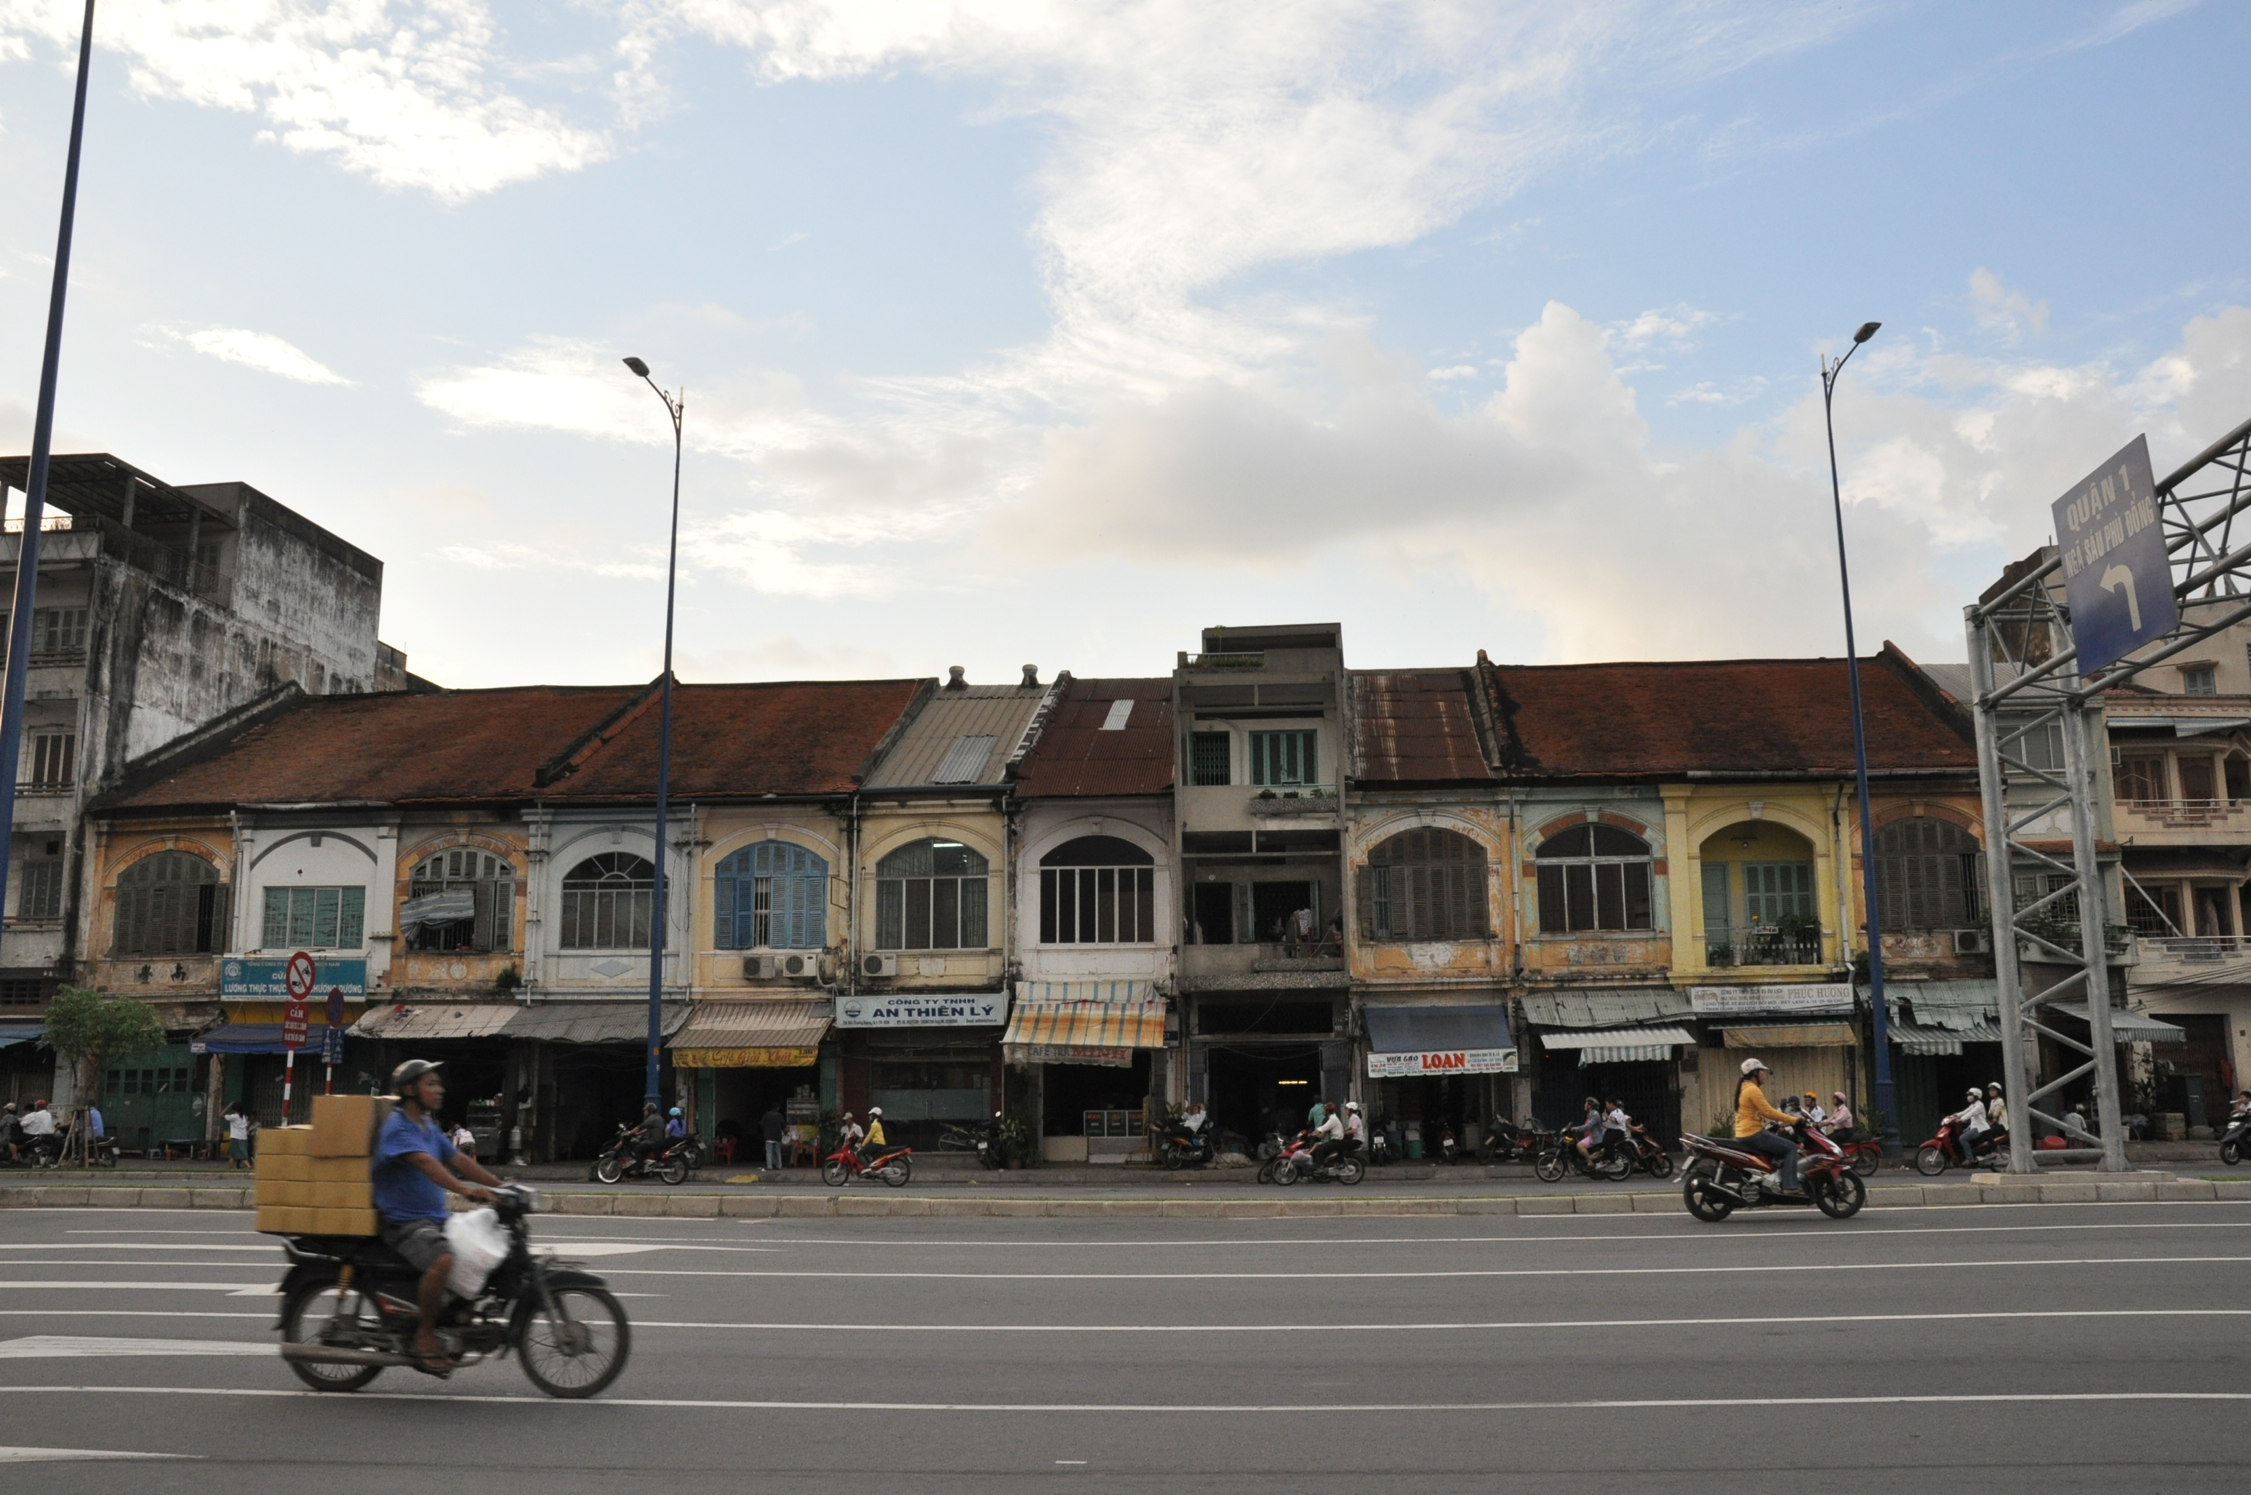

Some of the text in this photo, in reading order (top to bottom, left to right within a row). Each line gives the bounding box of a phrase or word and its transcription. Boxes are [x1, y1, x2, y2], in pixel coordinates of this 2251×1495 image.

[2066, 463, 2130, 531] QUẬN 1
[2064, 540, 2085, 578] NGÃ
[2084, 528, 2104, 565] SÁU
[2104, 512, 2124, 552] PHÙ
[1788, 986, 1814, 999] PHÚC
[1816, 986, 1850, 998] HƯƠNG
[872, 1004, 994, 1017] AN THIÊN LÝ
[1422, 1052, 1466, 1069] LOAN
